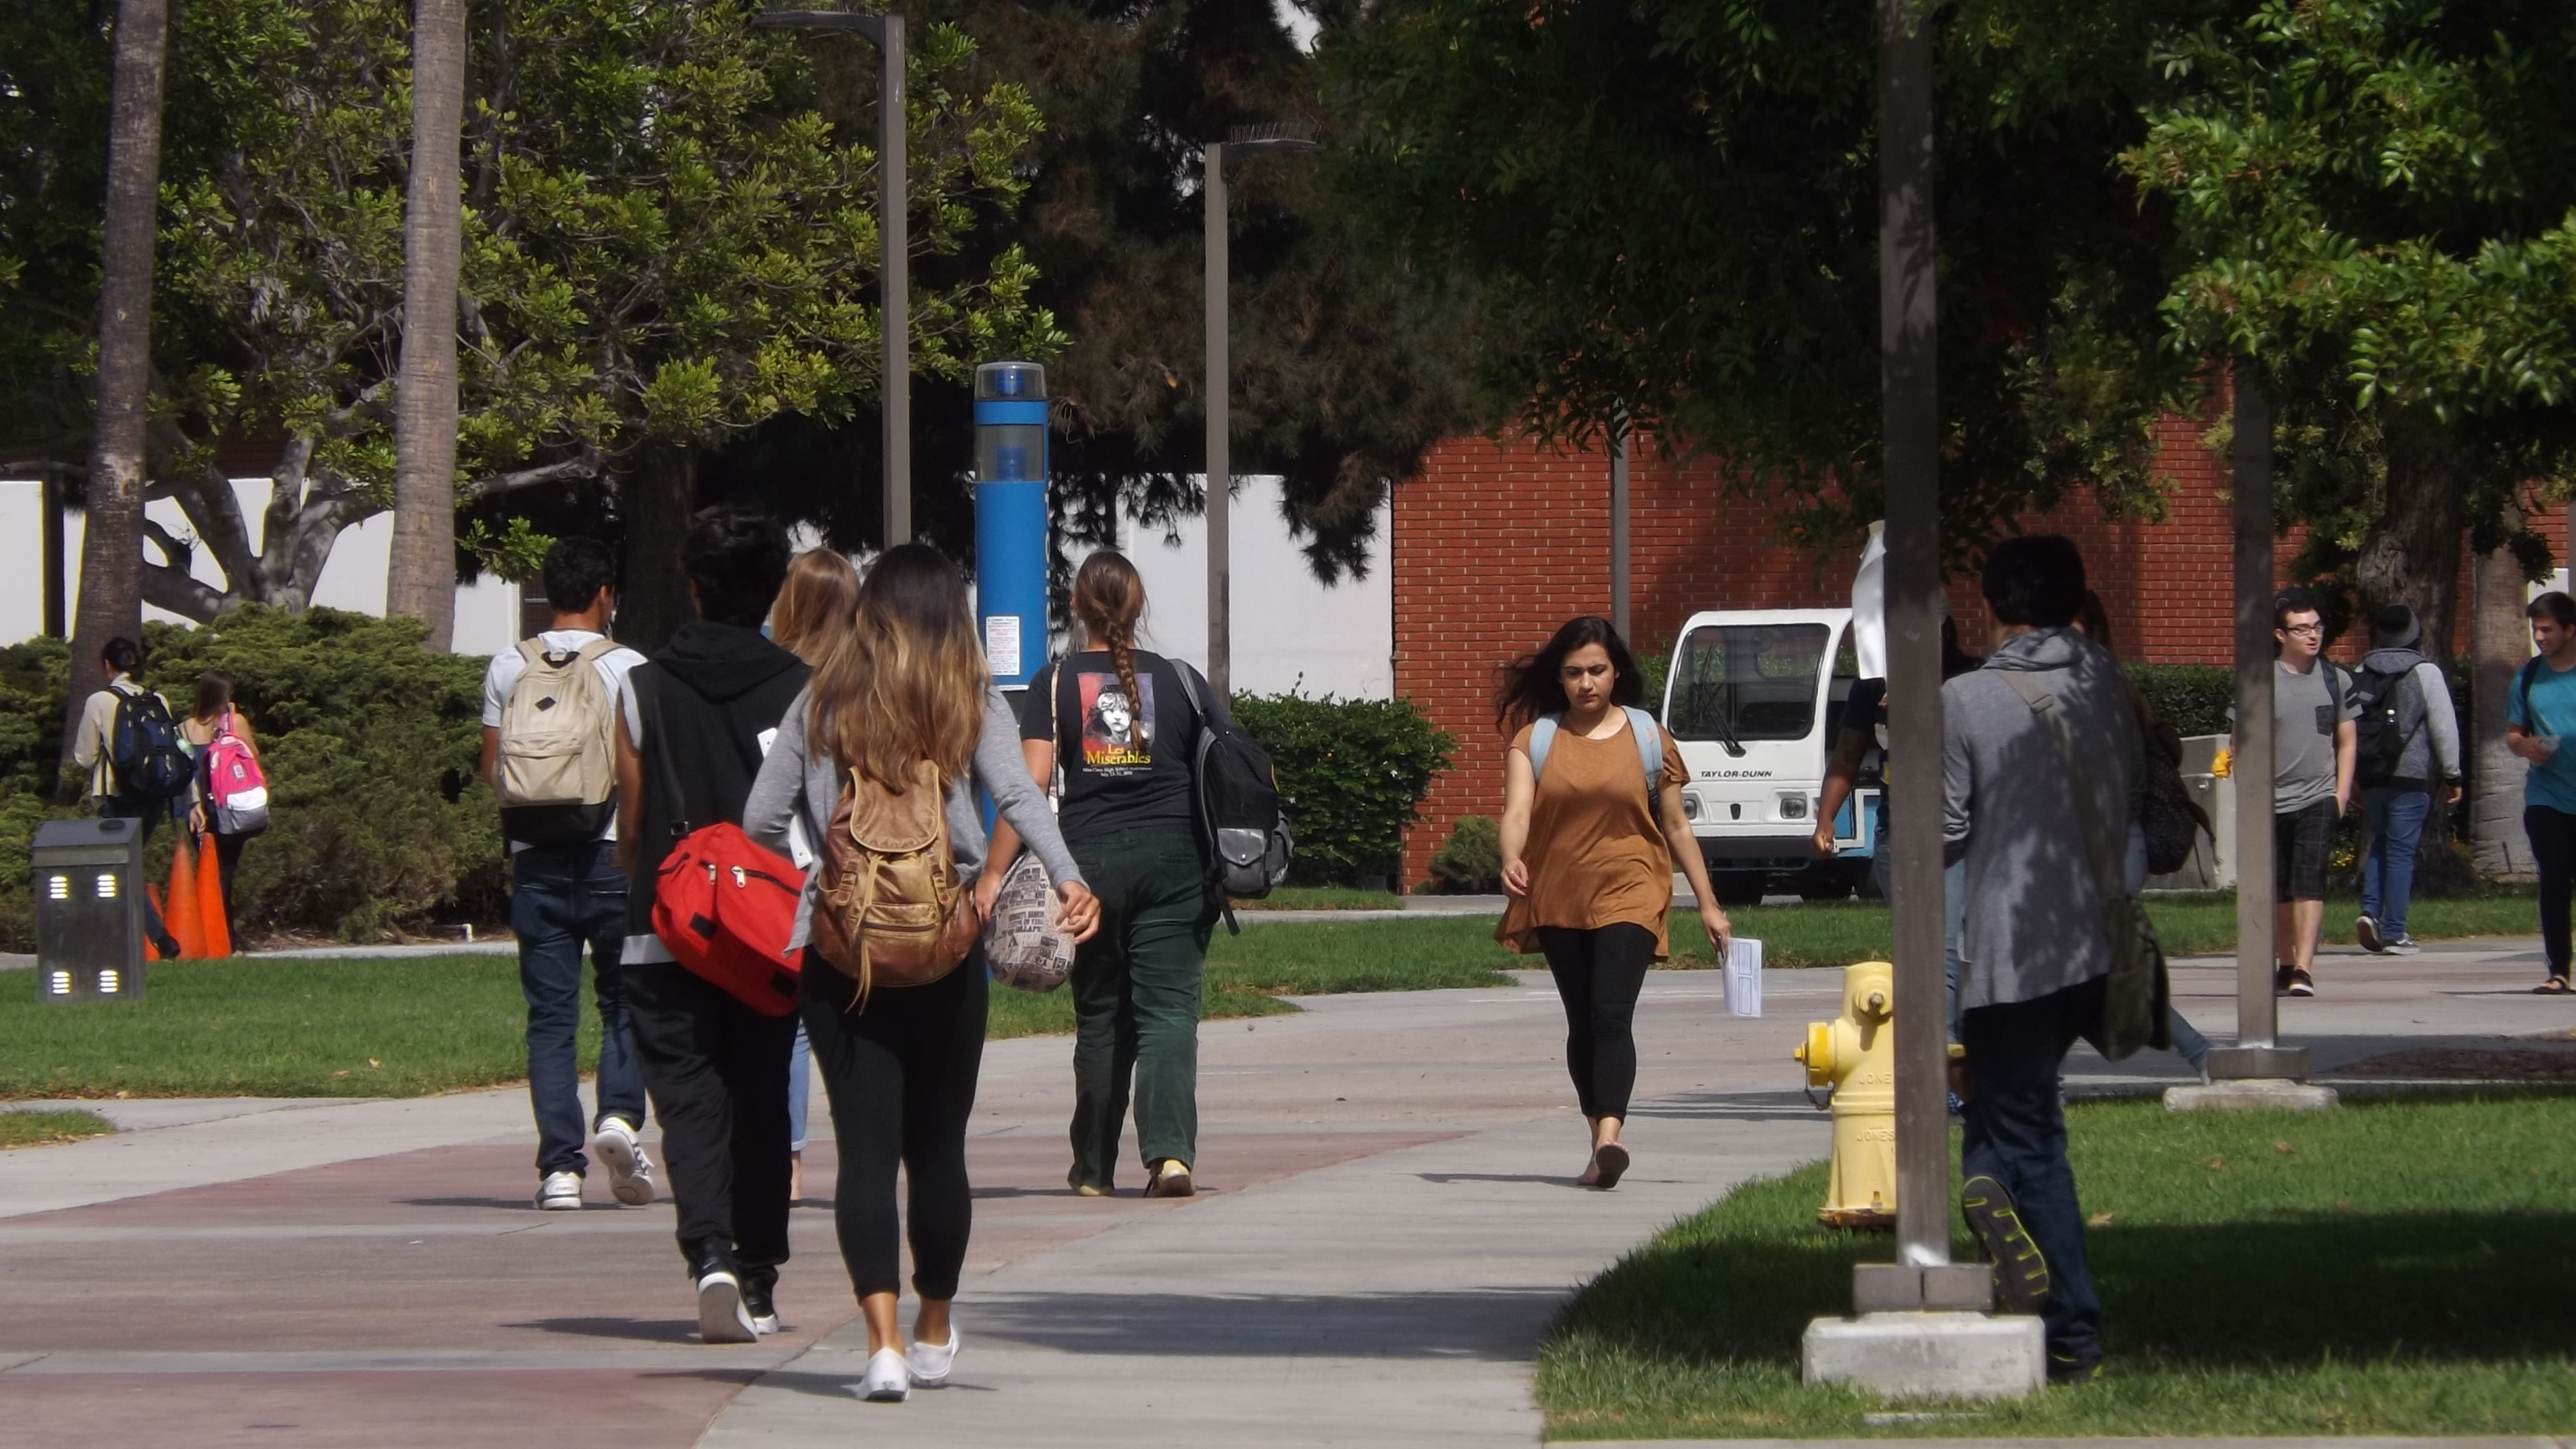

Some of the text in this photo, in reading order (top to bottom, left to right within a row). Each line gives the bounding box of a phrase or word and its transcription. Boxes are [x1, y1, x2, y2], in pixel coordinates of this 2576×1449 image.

[1108, 744, 1124, 754] Les
[1701, 770, 1773, 778] TAYLOR-DUNN
[1858, 1072, 1892, 1085] JONE
[1857, 1130, 1894, 1142] JONES
